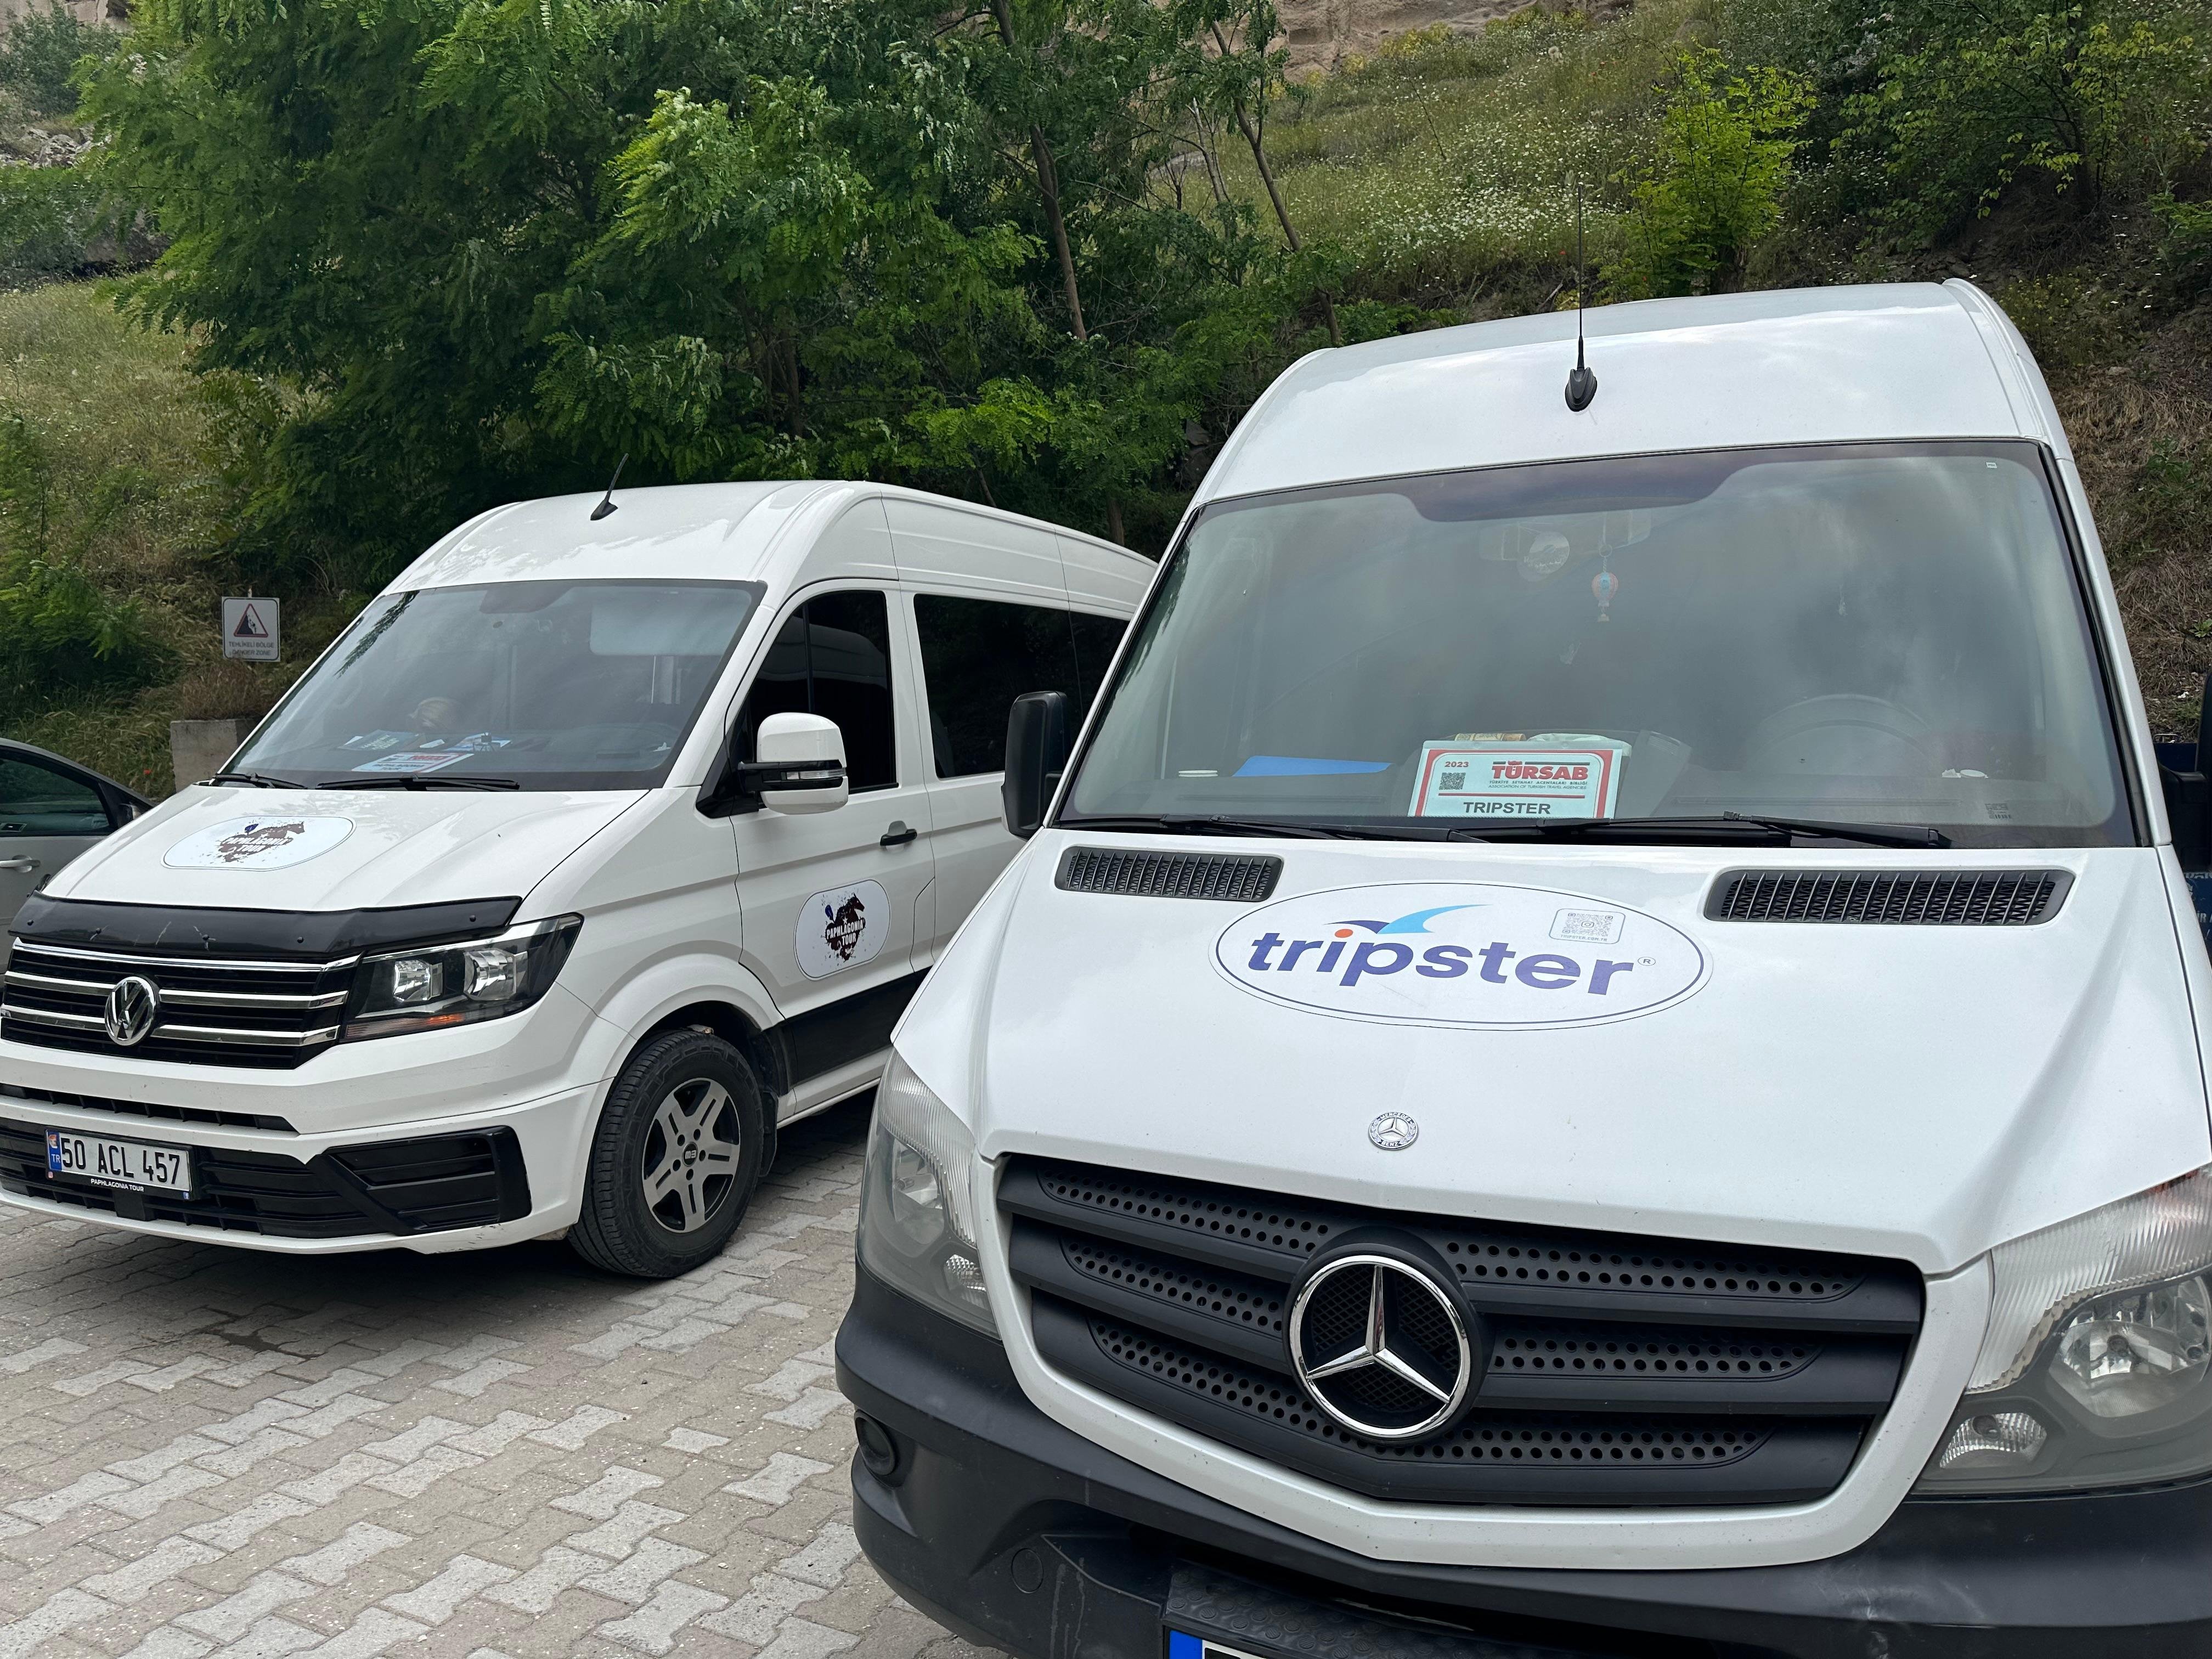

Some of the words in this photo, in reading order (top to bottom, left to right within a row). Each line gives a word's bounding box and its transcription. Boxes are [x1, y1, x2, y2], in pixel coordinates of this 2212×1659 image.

[1492, 761, 1588, 780] TÜRSAB
[1463, 802, 1551, 814] TRIPSTER
[826, 919, 864, 940] PAPHLAGONIA
[842, 932, 856, 946] TOUR
[1248, 928, 1634, 996] tripster
[51, 1154, 61, 1163] TR
[61, 1137, 86, 1170] 50
[98, 1143, 134, 1178] ACL
[143, 1150, 180, 1184] 457
[91, 1178, 128, 1189] PAPHLAGONIA
